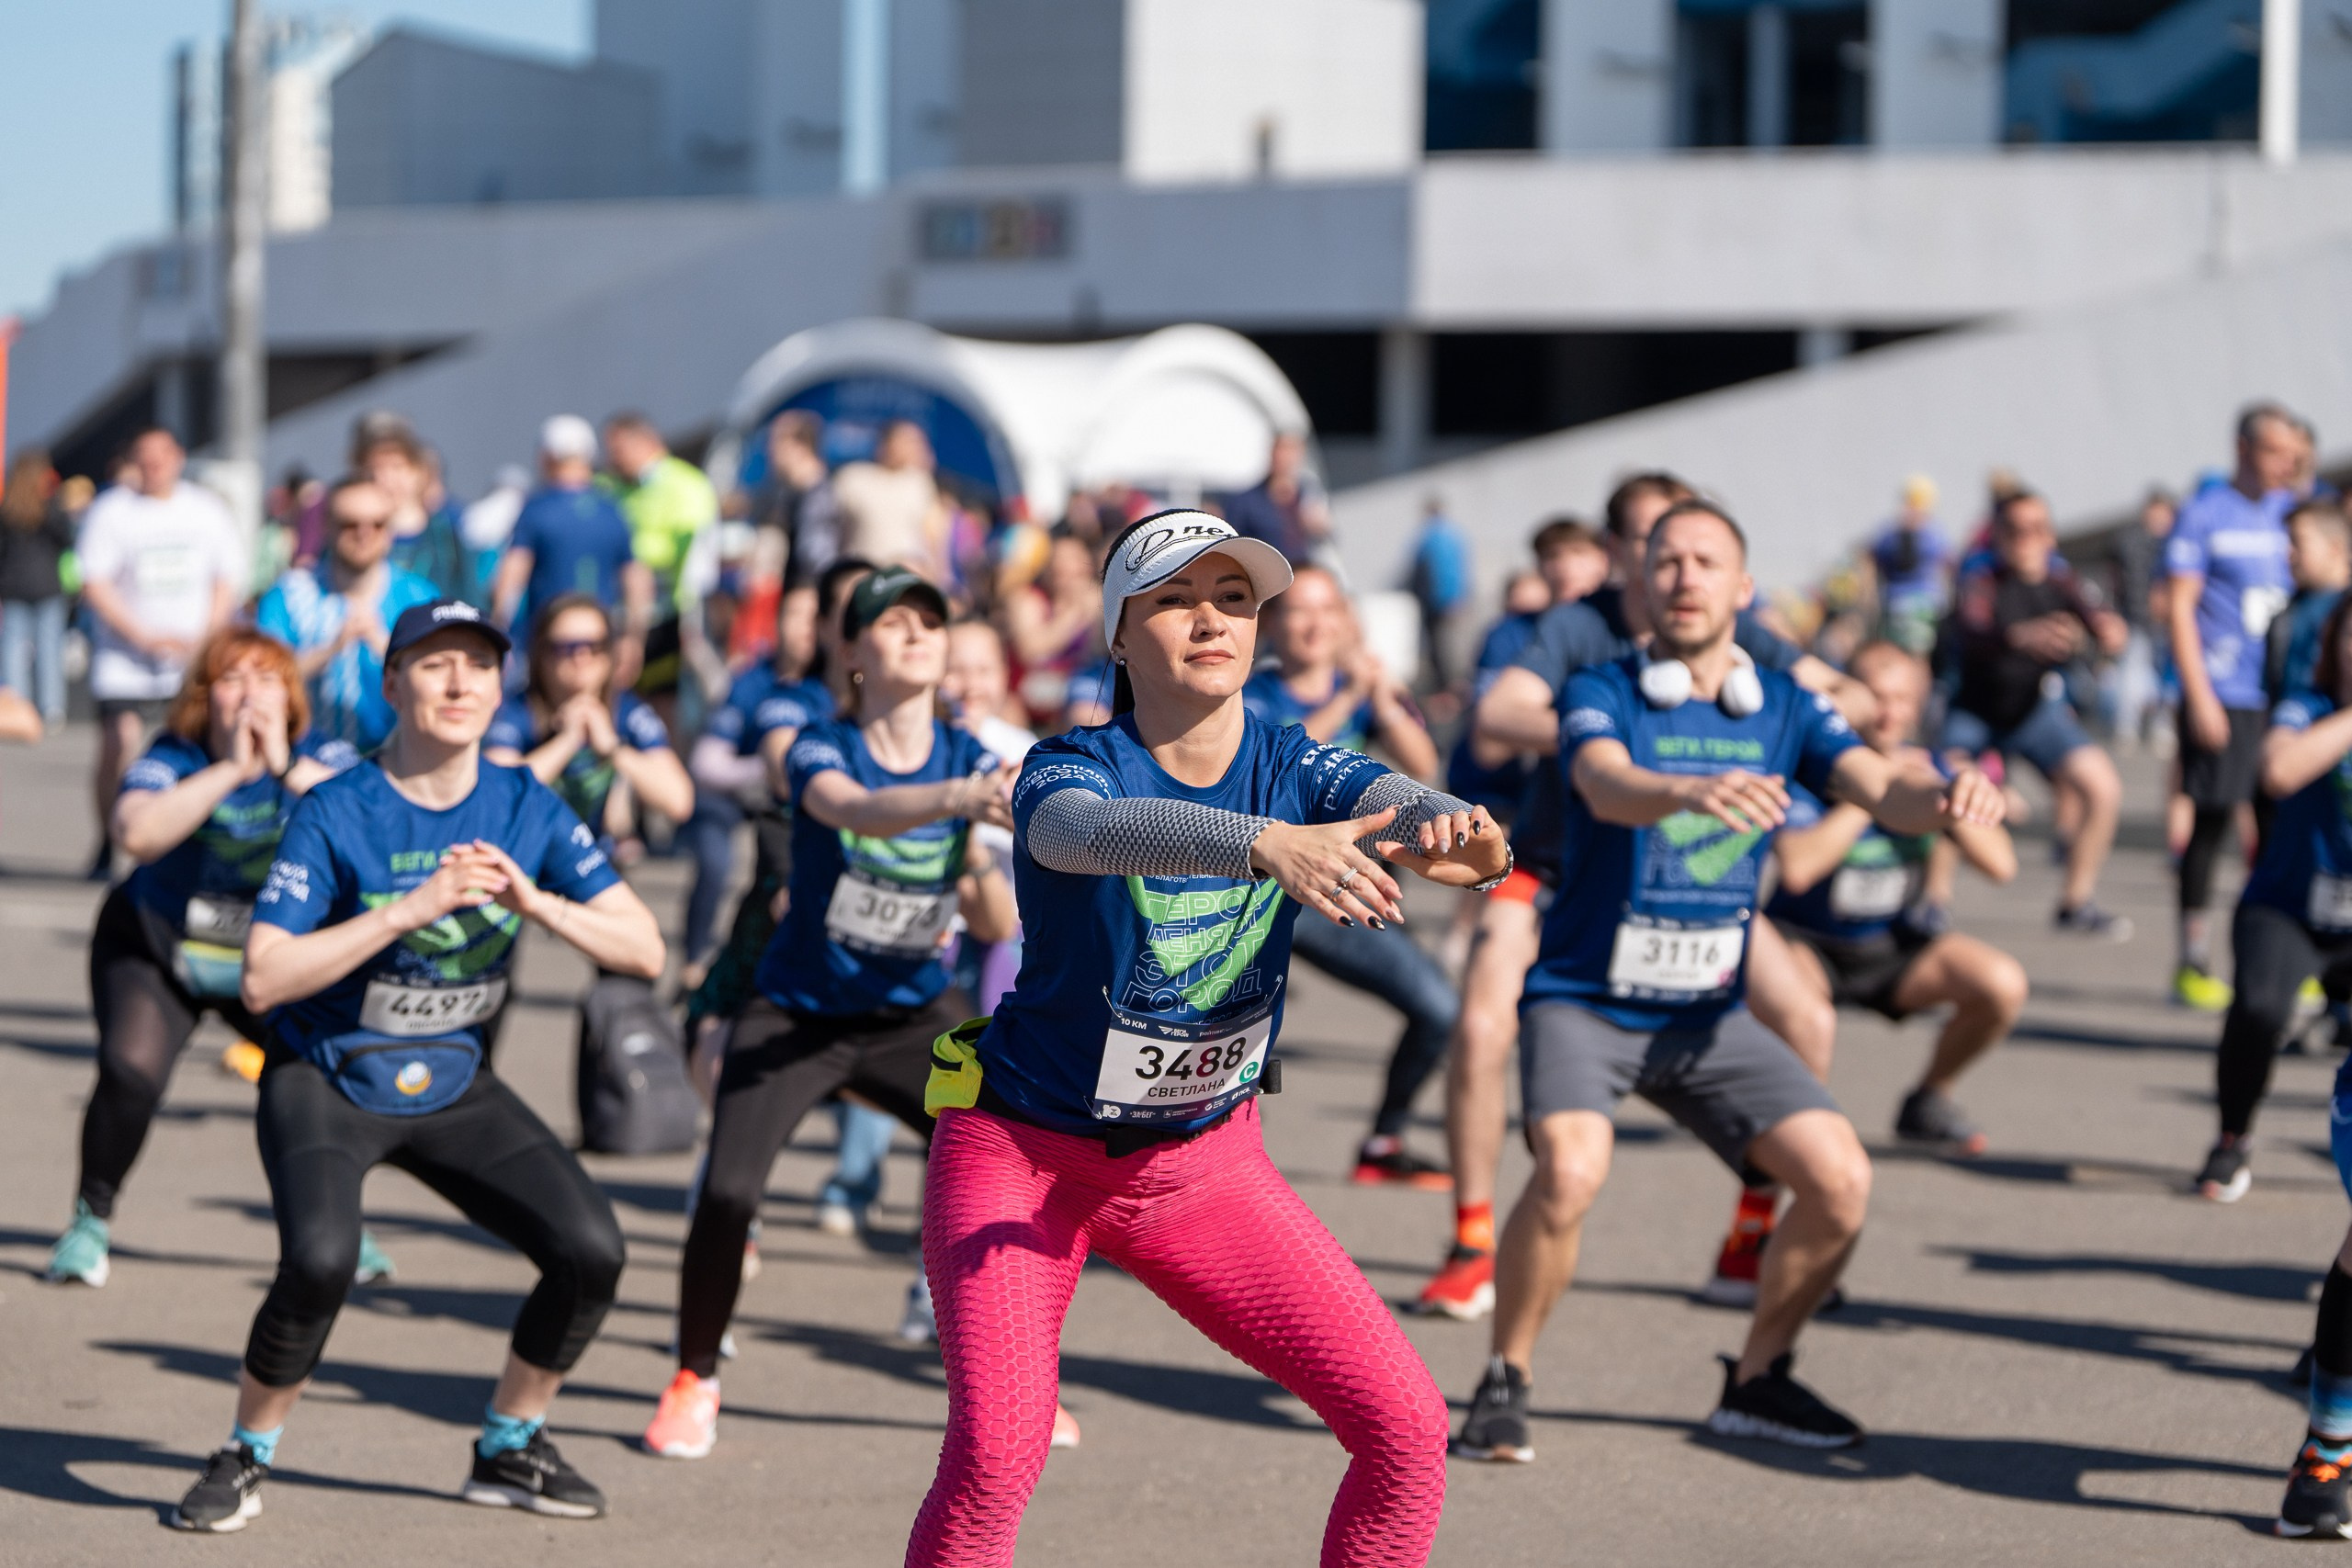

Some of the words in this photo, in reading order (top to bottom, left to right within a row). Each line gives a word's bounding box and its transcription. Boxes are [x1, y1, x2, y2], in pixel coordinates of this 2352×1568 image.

[1036, 773, 1086, 790] 2024
[1643, 937, 1720, 965] 3116
[390, 991, 481, 1015] 4497
[1121, 969, 1262, 1013] ГОРОД
[1121, 1018, 1130, 1026] 10
[1135, 1036, 1247, 1080] 3488
[1148, 1078, 1225, 1098] СВЕТЛАНА
